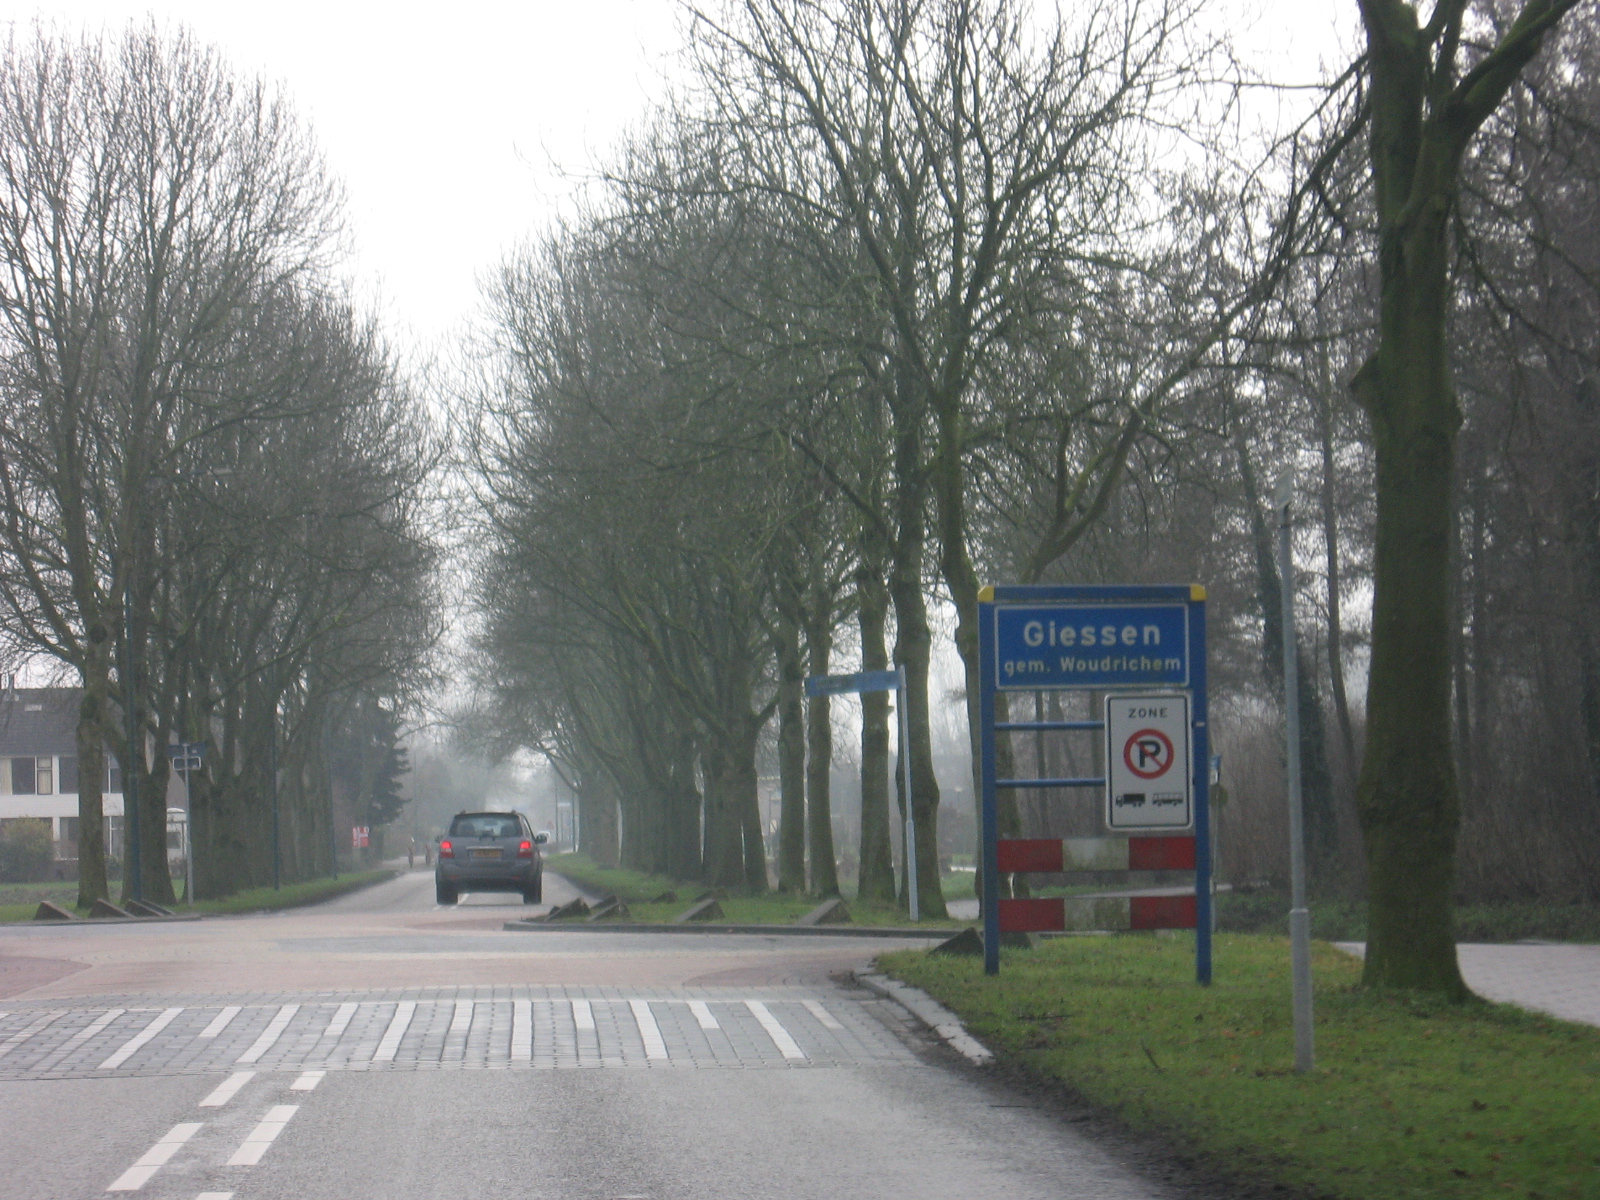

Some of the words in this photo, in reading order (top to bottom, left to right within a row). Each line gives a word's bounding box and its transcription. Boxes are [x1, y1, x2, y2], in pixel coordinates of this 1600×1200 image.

[1023, 620, 1161, 647] Giessen
[1004, 658, 1051, 677] gem.
[1061, 655, 1181, 673] Woudrichem
[1128, 707, 1168, 719] ZONE
